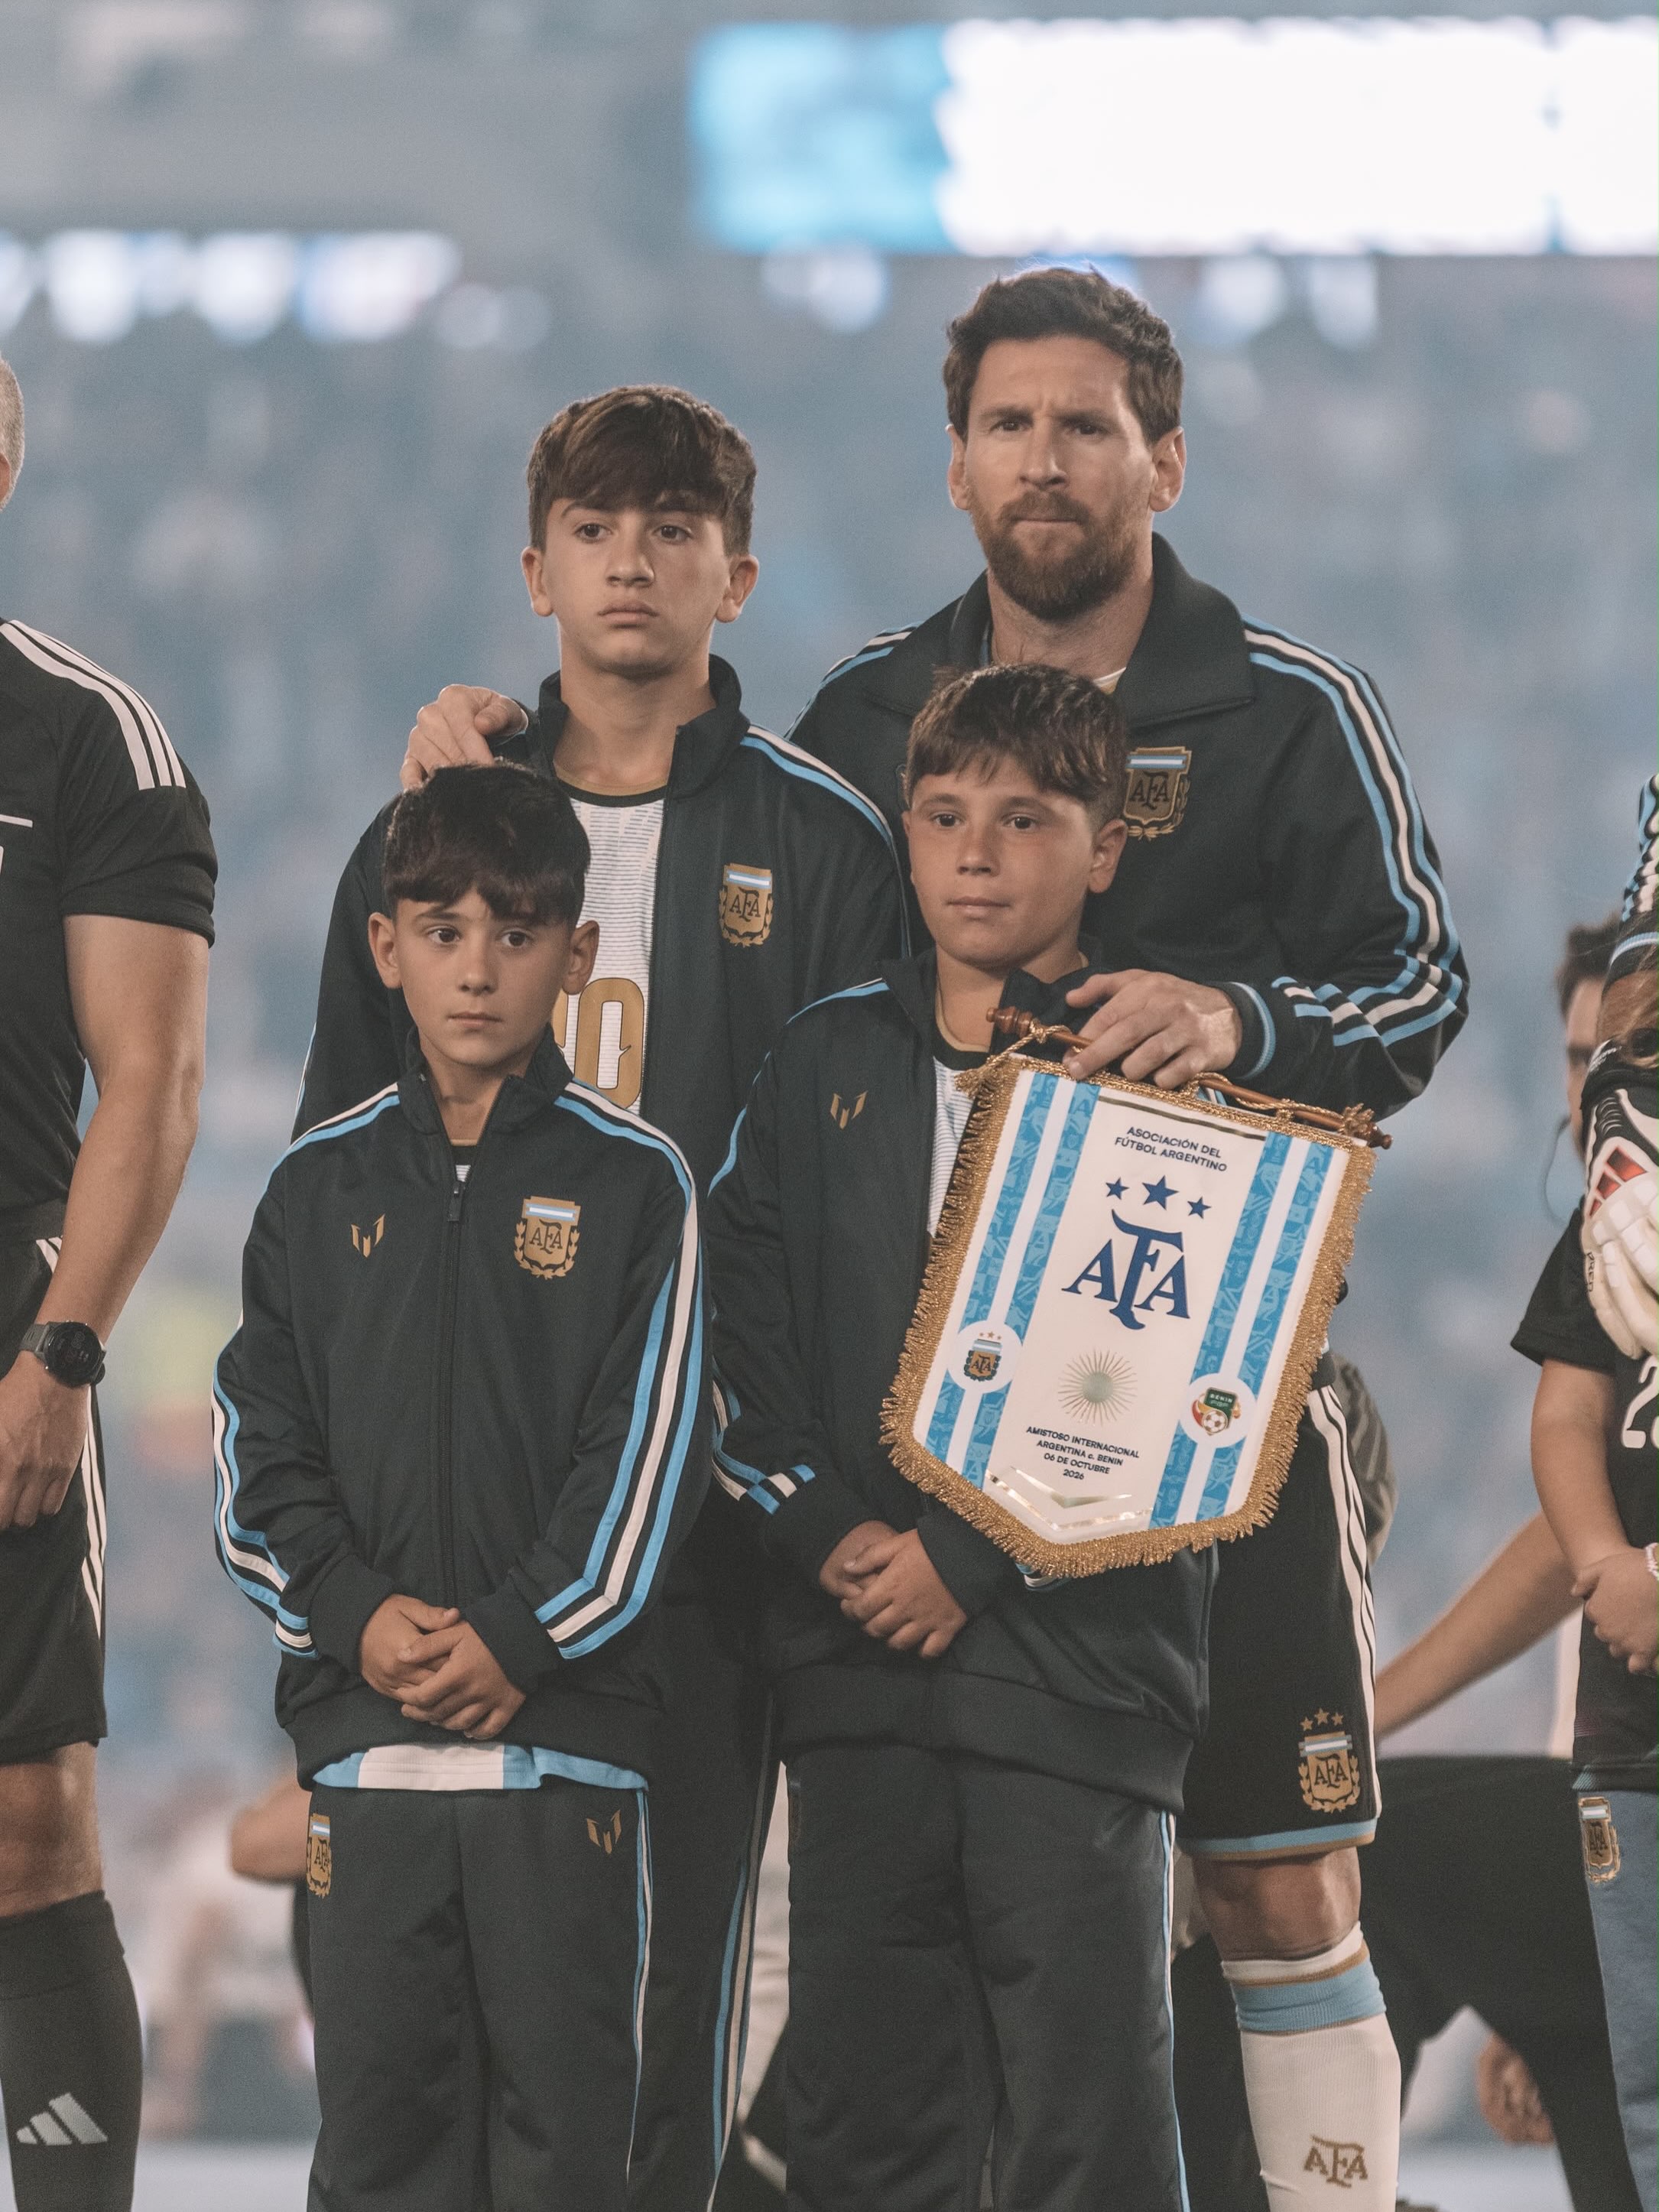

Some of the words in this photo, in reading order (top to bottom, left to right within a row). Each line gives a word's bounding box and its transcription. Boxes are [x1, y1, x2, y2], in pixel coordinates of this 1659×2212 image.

[1129, 770, 1170, 810] AFA
[729, 887, 761, 922] AFA
[1115, 1136, 1157, 1155] FÚTBOL
[1160, 1148, 1227, 1172] ARGENTINO
[1127, 1126, 1199, 1151] ASOCIACIÓN
[1200, 1145, 1221, 1158] DEL
[529, 1218, 563, 1255] AFA
[1061, 1209, 1190, 1330] AFA
[971, 1353, 992, 1374] AFA
[1026, 1426, 1070, 1442] AMISTOSO
[1071, 1435, 1140, 1458] INTERNACIONAL
[1037, 1440, 1086, 1457] ARGENTINA
[1097, 1454, 1124, 1466] BENIN
[1044, 1453, 1055, 1461] 06
[1057, 1455, 1069, 1465] DE
[1070, 1459, 1111, 1474] OCTUBRE
[1063, 1469, 1085, 1480] 2026
[1314, 1753, 1349, 1788] AFA
[1304, 2136, 1368, 2188] AFA
